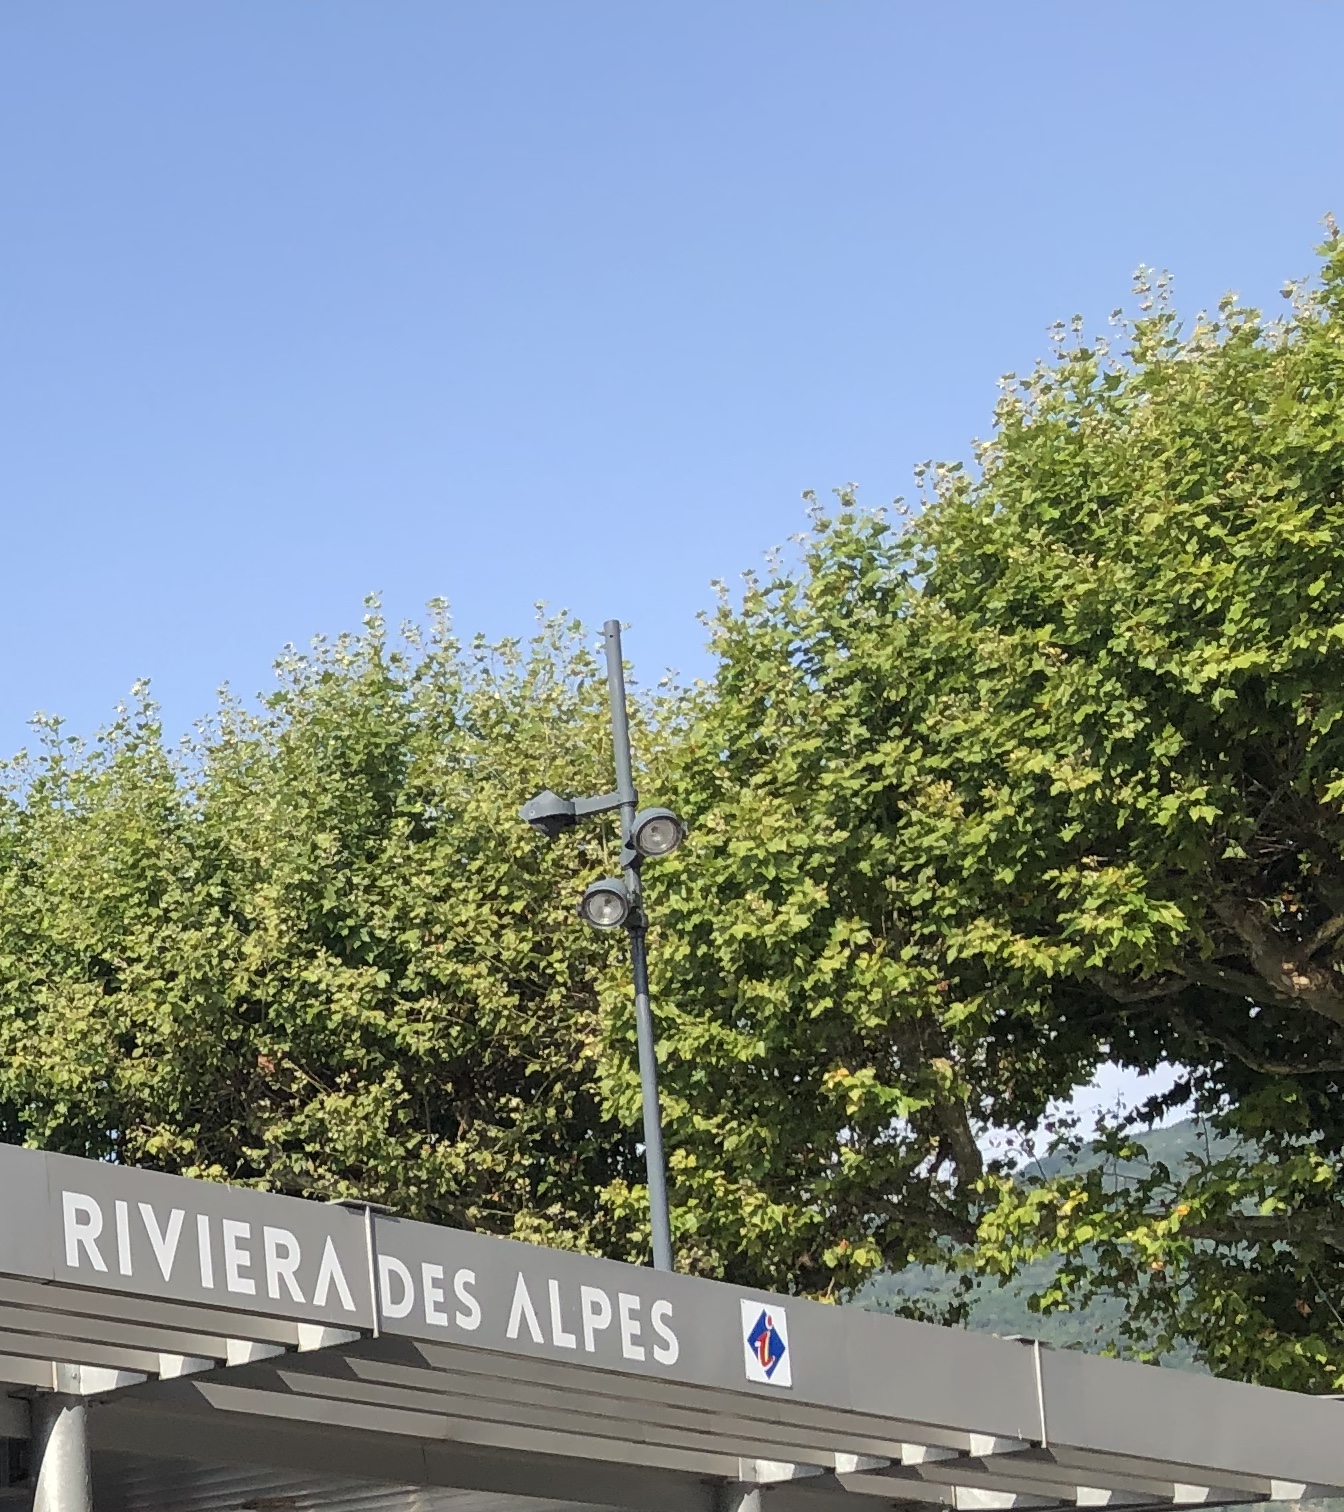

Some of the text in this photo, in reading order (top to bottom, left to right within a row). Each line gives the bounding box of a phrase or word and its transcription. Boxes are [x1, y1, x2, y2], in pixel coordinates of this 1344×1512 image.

[62, 1191, 356, 1311] RIVIERA
[379, 1255, 481, 1331] DES
[507, 1271, 679, 1365] ALPES
